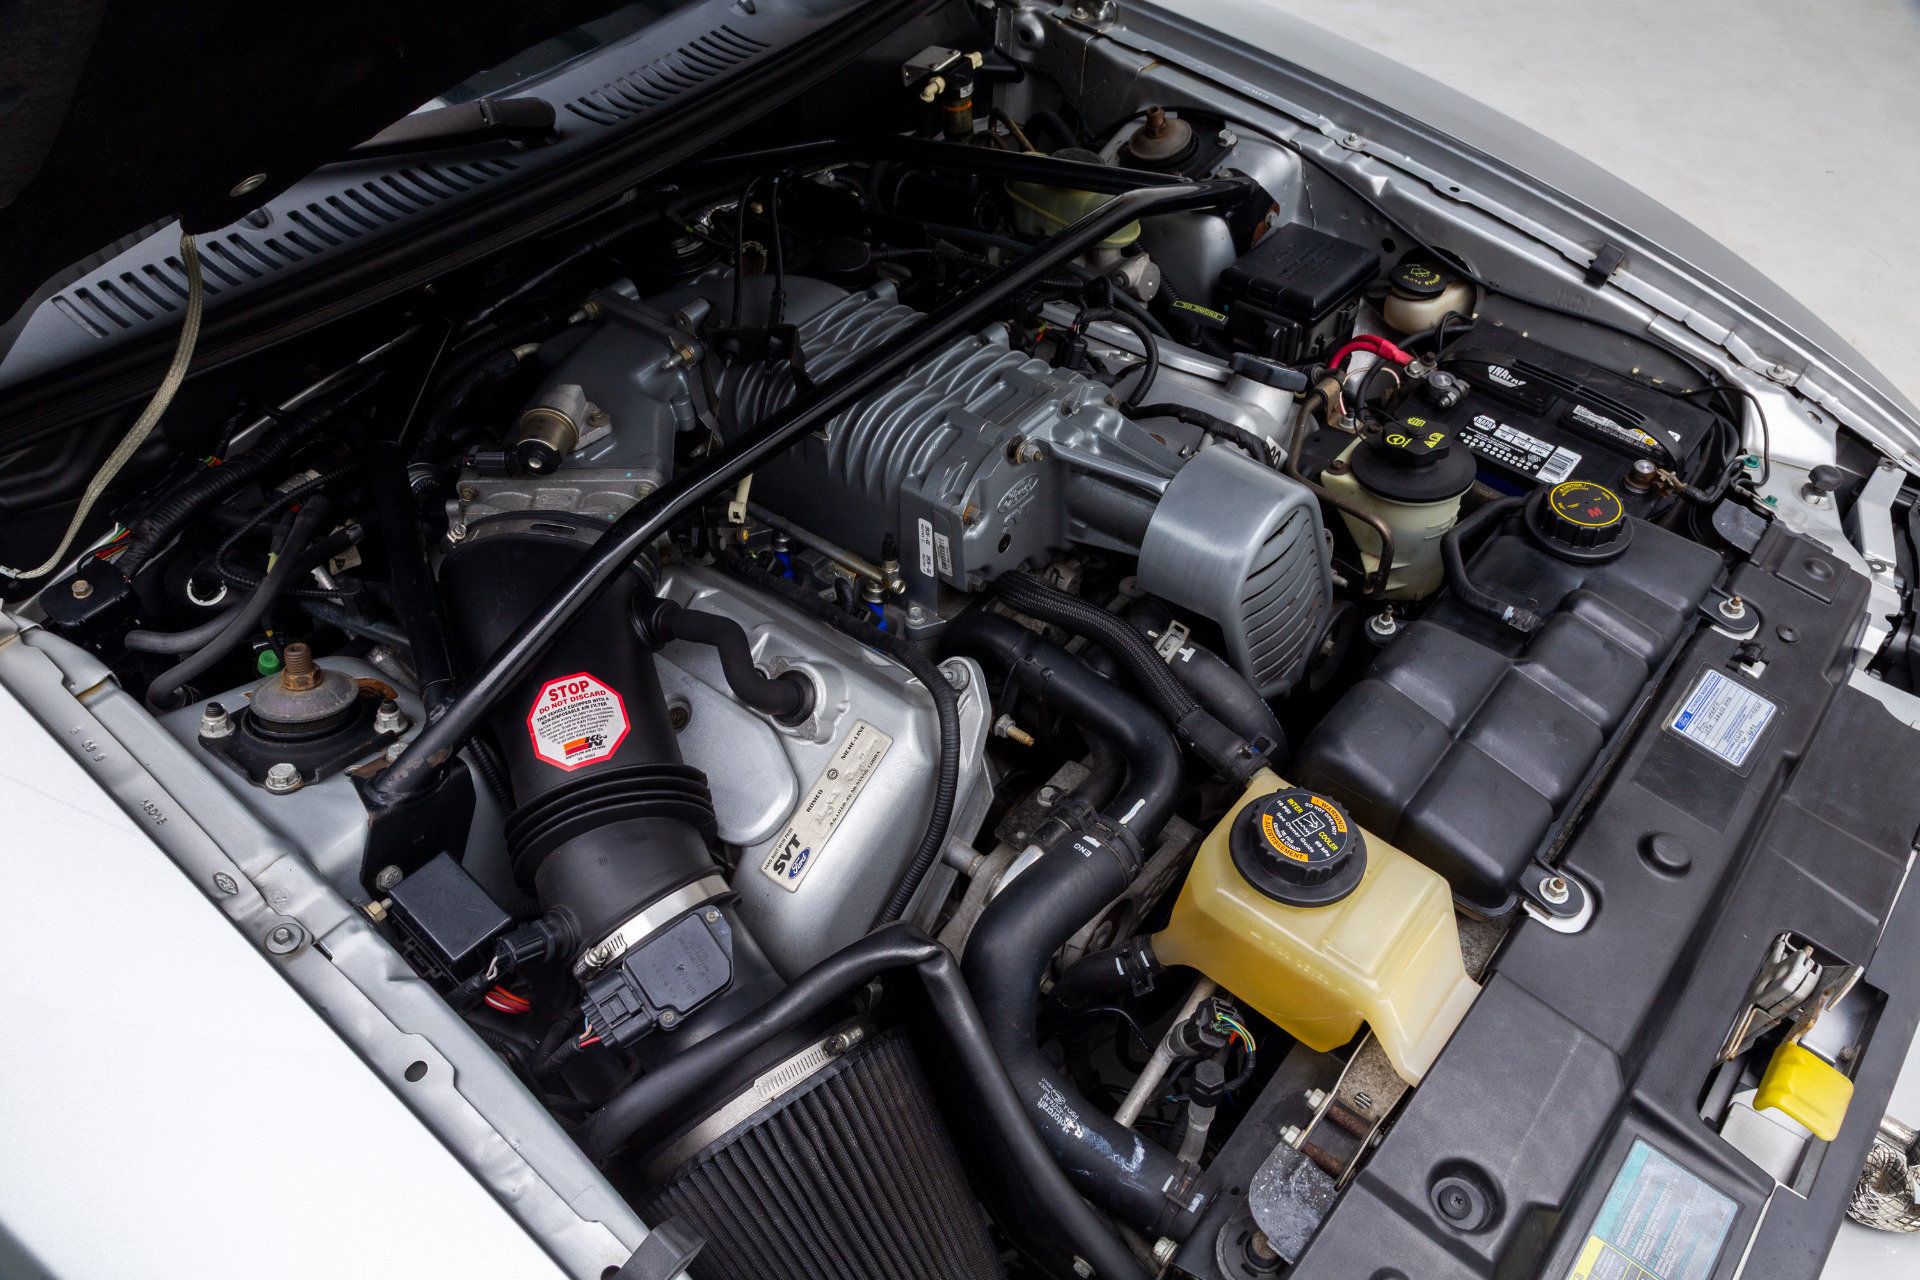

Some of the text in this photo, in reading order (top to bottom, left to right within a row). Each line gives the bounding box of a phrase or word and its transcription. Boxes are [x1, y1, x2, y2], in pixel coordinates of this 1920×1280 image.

[1476, 416, 1495, 430] NAPA
[549, 681, 589, 701] STOP
[552, 699, 567, 708] NOT
[570, 690, 606, 703] DISCARD
[540, 708, 581, 725] NON-DISPOSABLE
[548, 707, 567, 716] VEHICLE
[568, 700, 591, 709] EQUIPPED
[807, 790, 823, 812] ROMEO
[841, 725, 865, 759] NICHE-LINE
[1282, 805, 1292, 814] PSI
[1287, 798, 1303, 814] INTER
[1314, 805, 1325, 813] NOT
[1321, 800, 1345, 830] WARNING
[1265, 821, 1303, 860] AVERTISSEMENT
[1276, 812, 1314, 853] See Owner Guide
[1319, 831, 1338, 851] COOLER
[774, 834, 800, 875] SVT
[1073, 842, 1092, 858] ENG
